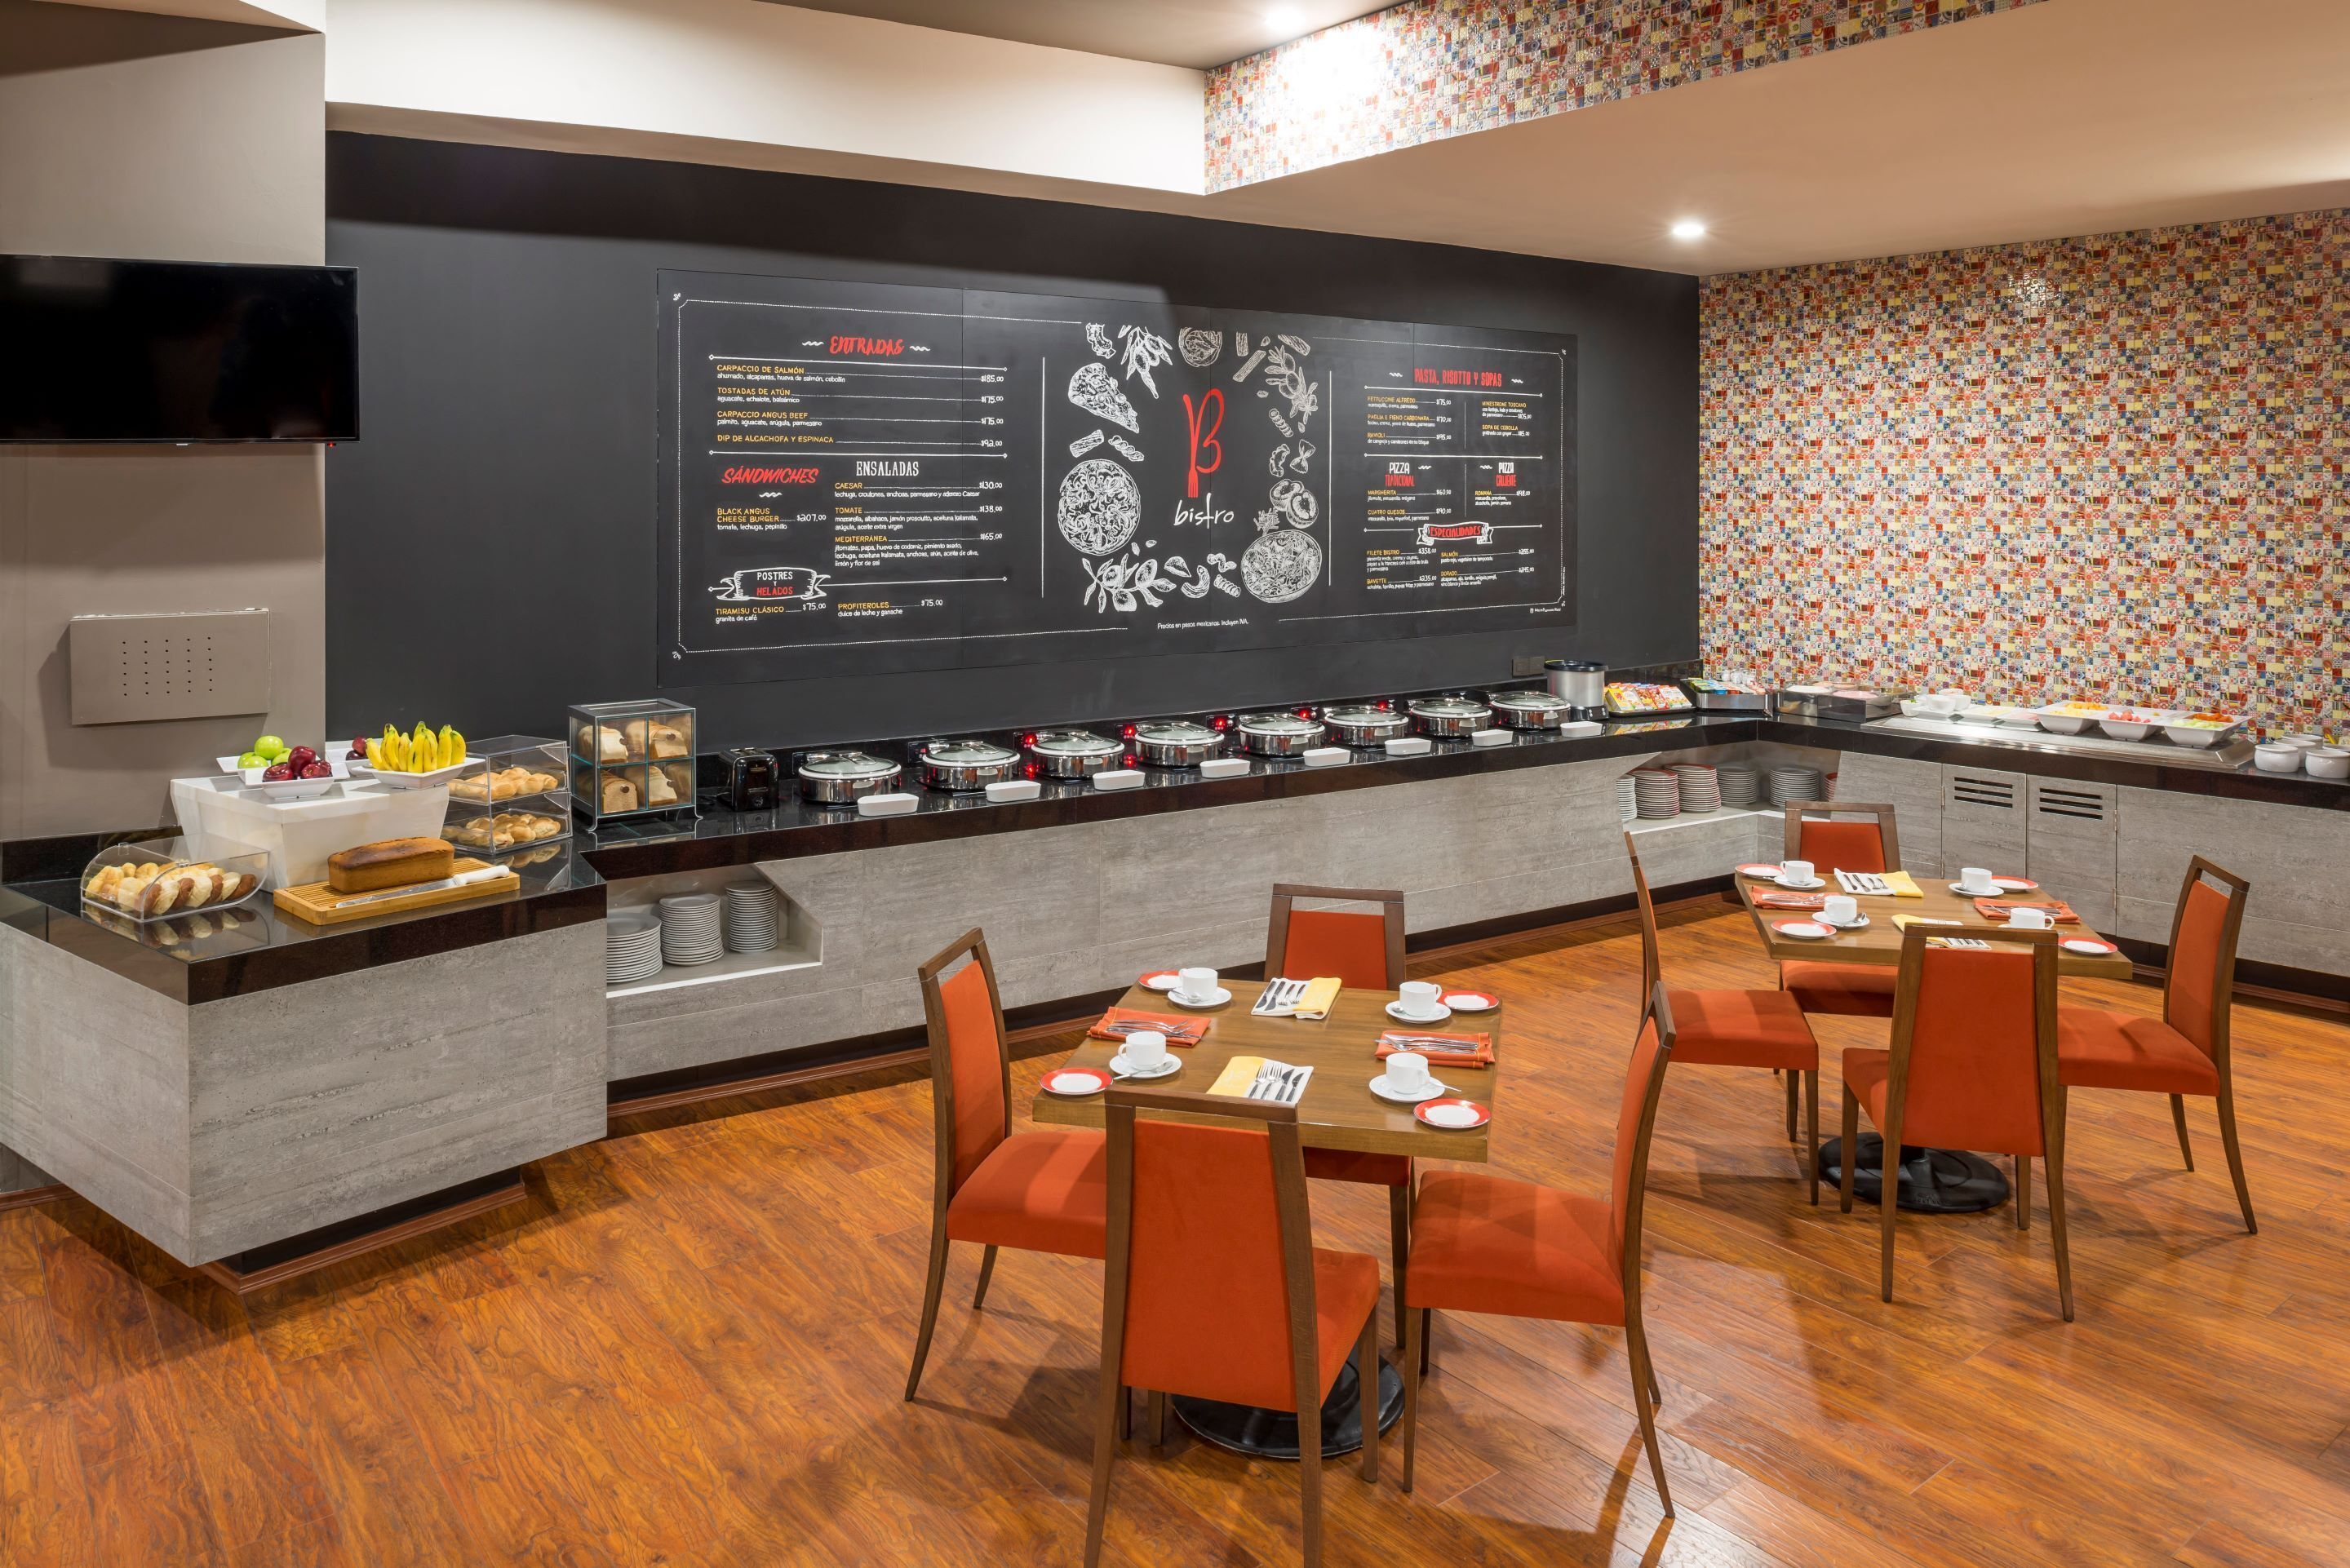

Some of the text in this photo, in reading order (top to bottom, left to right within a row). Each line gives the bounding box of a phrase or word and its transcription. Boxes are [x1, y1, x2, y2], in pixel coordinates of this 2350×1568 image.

[829, 336, 905, 356] ENTRADAS
[1474, 372, 1478, 384] Y
[1481, 372, 1501, 387] SOPAS
[856, 461, 919, 476] ENSALADAS
[1390, 463, 1409, 474] PIZZA
[1499, 463, 1514, 473] PIZZA
[721, 466, 819, 484] SÁNDWICHES
[979, 481, 1002, 489] $130.00
[1173, 493, 1235, 529] bistro
[1430, 526, 1481, 538] ESPECIALIDADES
[757, 571, 793, 581] POSTRES
[756, 587, 793, 596] HELADOS
[753, 605, 784, 613] CLÁSICO
[803, 603, 826, 611] $75.00
[838, 602, 889, 610] PROFITEROLES
